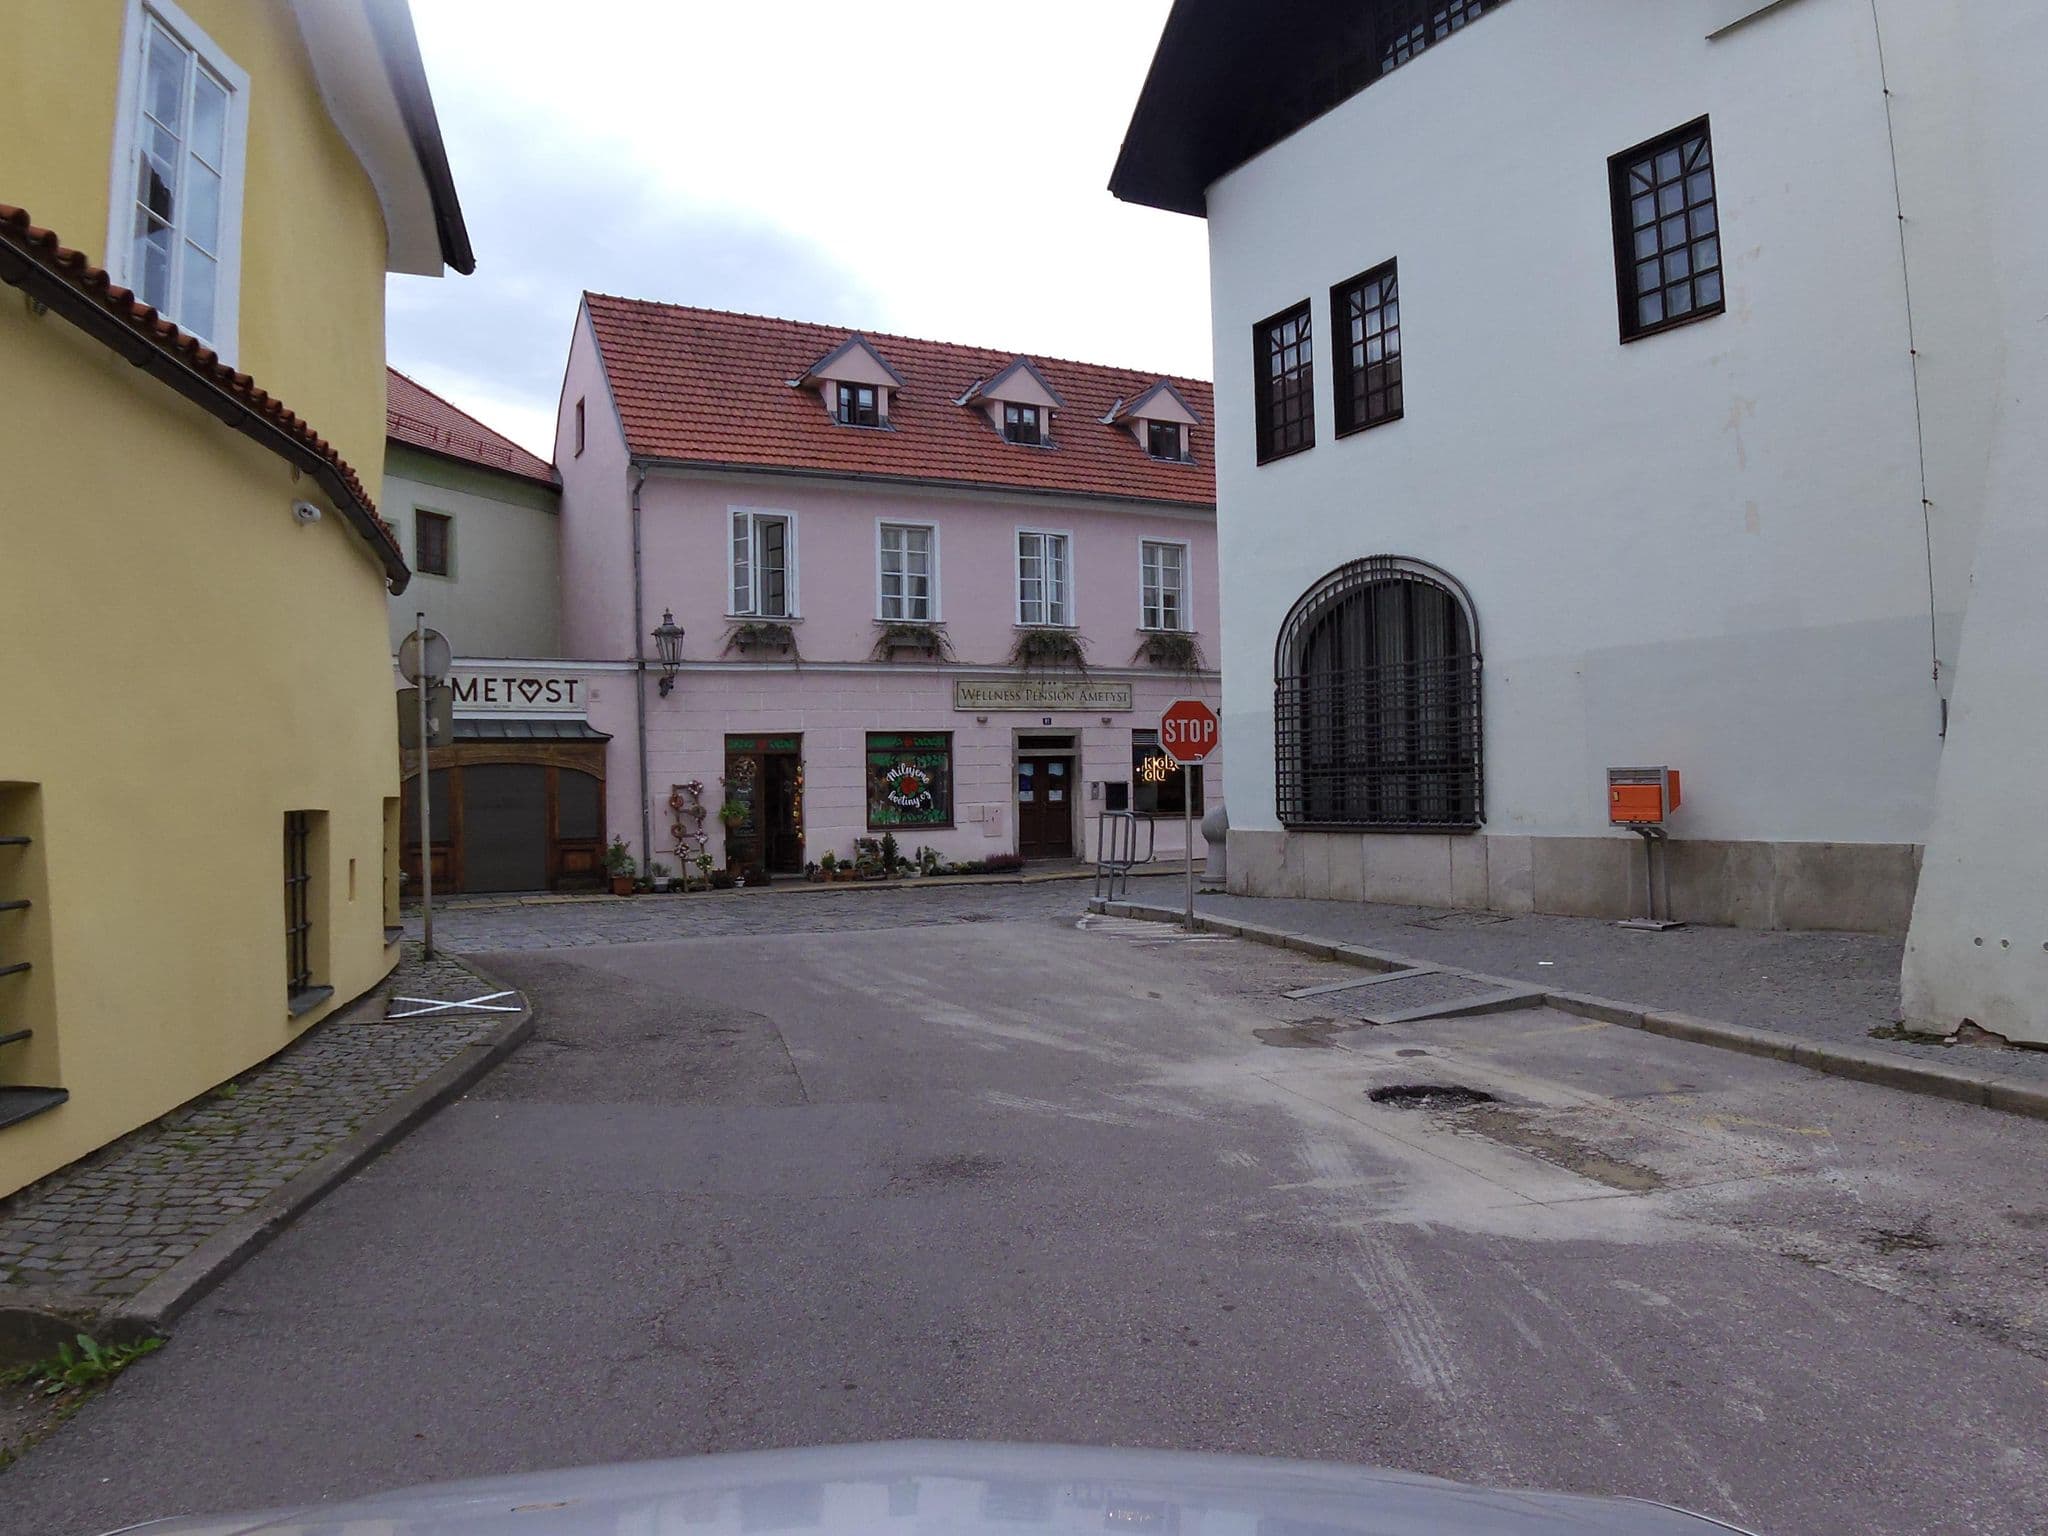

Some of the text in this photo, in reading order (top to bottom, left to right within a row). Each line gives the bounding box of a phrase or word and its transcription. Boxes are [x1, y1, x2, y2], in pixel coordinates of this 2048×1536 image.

[961, 688, 1128, 703] WELLNESS PENSION AMETYST
[1165, 718, 1214, 743] STOP
